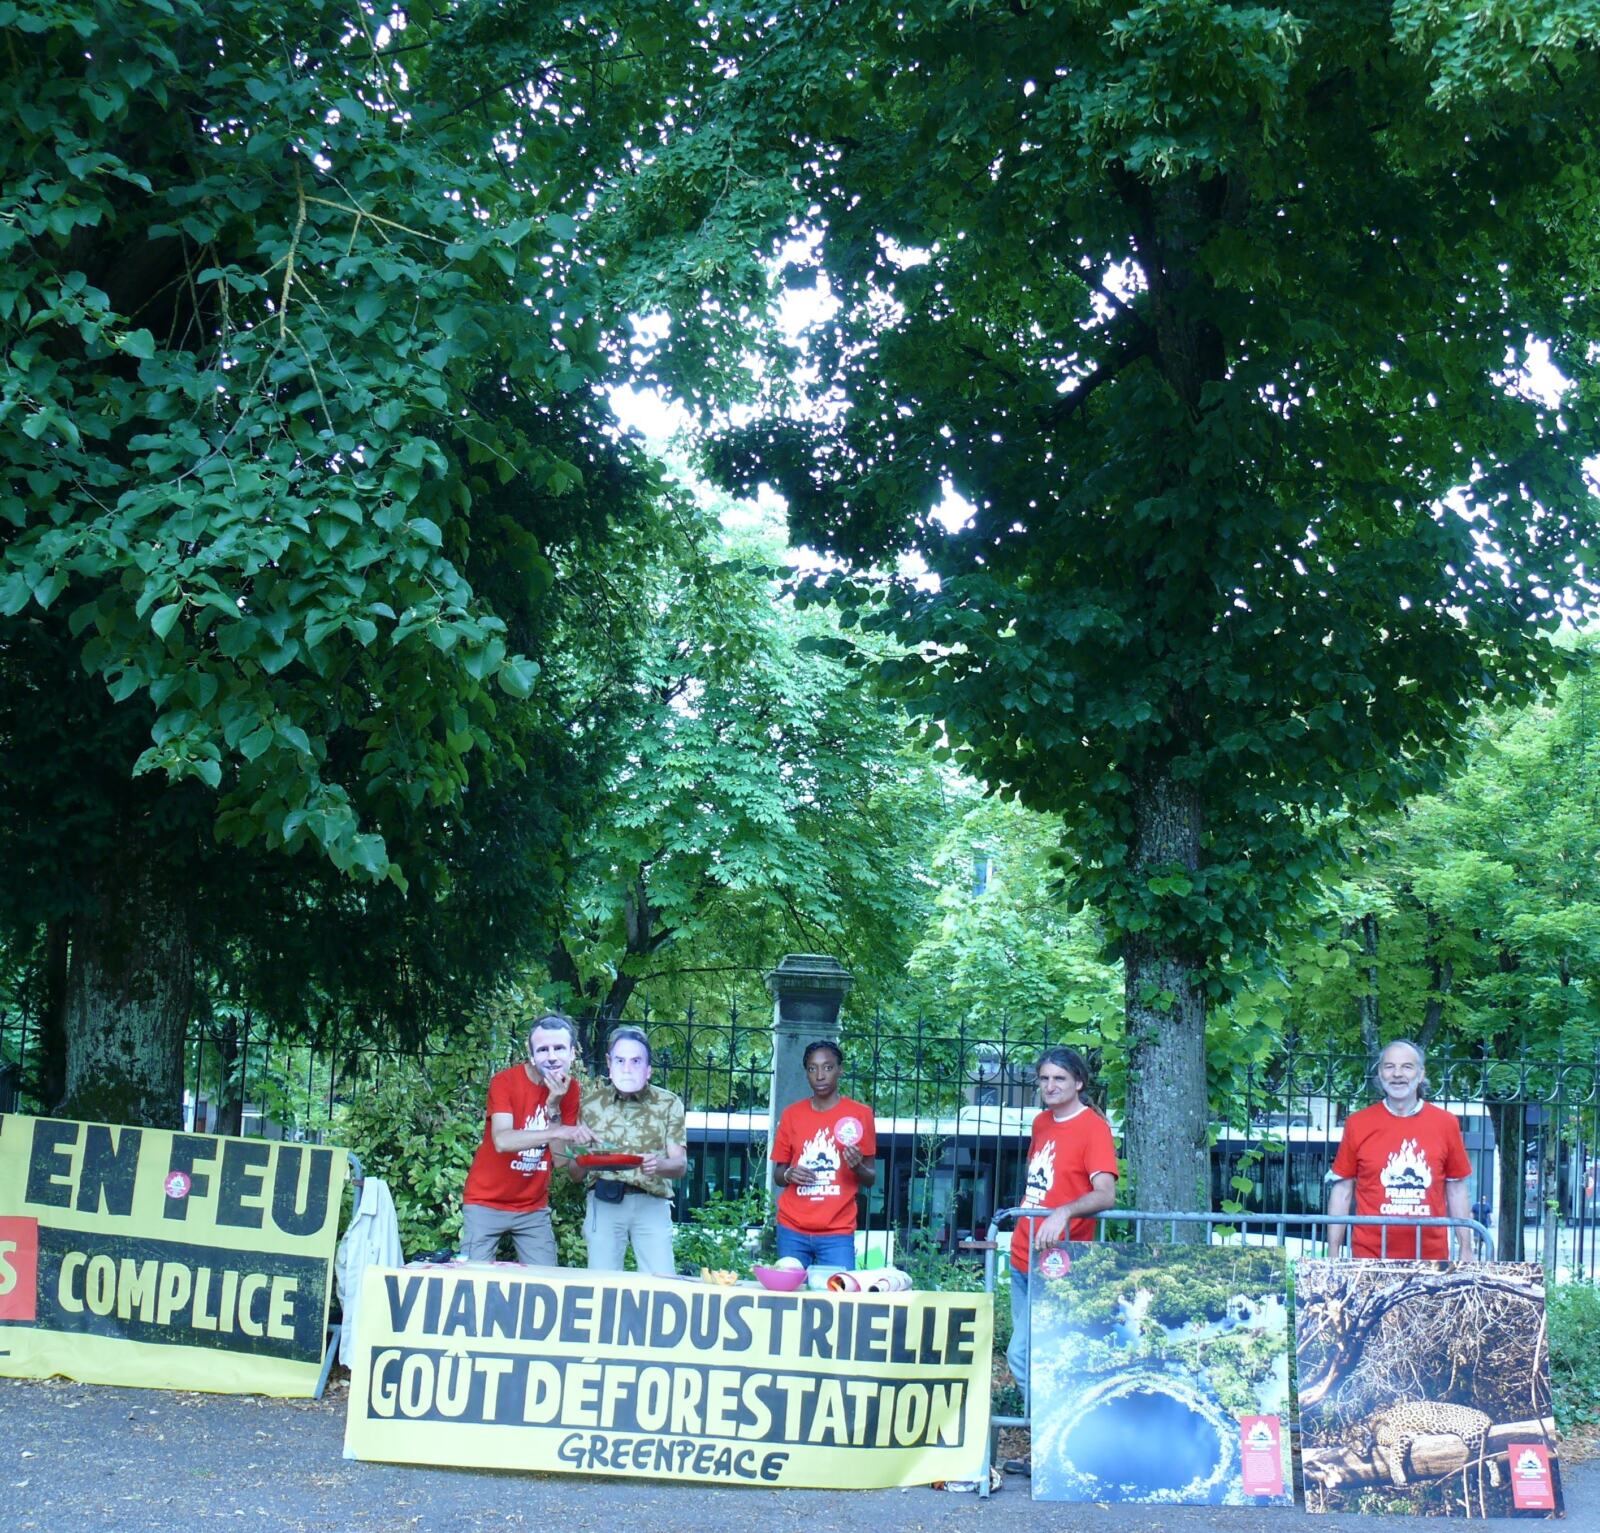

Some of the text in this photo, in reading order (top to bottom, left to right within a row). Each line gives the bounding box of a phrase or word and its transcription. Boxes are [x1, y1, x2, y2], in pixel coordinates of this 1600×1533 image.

[25, 1119, 333, 1236] EN FEU
[58, 1251, 299, 1340] COMPLICE
[371, 1349, 963, 1447] GOÛT DÉFORESTATION
[557, 1432, 790, 1481] GREENPEACE
